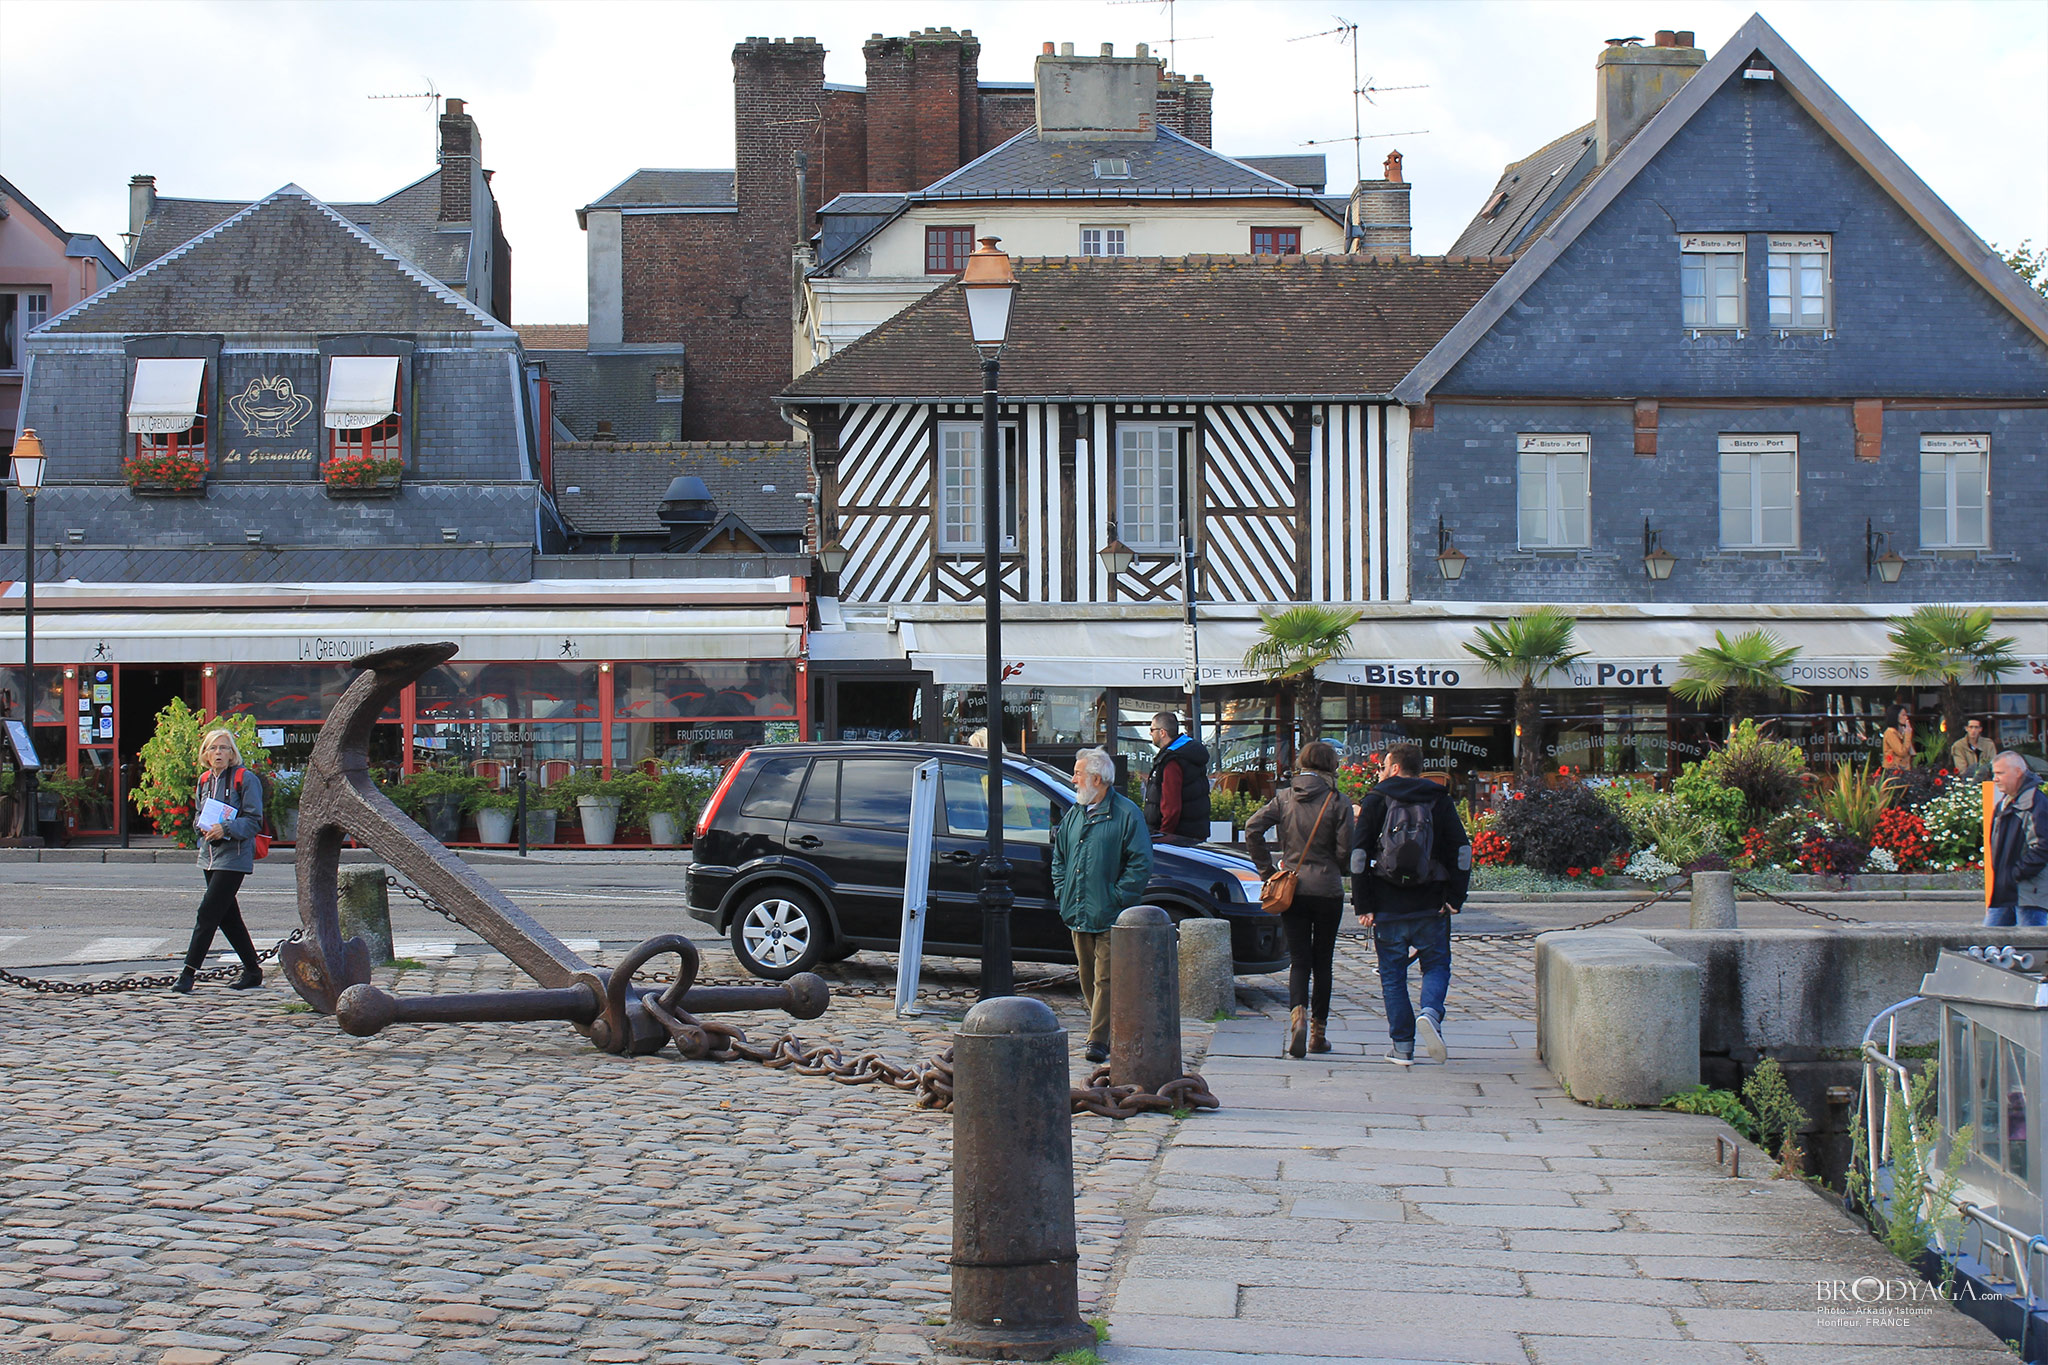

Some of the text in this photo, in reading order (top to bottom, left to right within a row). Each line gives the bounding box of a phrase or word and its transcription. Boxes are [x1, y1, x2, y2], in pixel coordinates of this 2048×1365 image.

[1700, 240, 1721, 248] Bistro
[1726, 239, 1741, 248] Port
[1772, 240, 1793, 248] Bistro
[1797, 240, 1812, 248] Port
[137, 415, 188, 432] LA GRENOUILLE
[333, 413, 342, 427] LA
[1766, 439, 1784, 447] Port
[223, 448, 313, 463] La Grenouille
[298, 637, 375, 661] LA GRENOUILLE
[1143, 668, 1185, 680] FRUIT
[1202, 668, 1222, 679] DE
[1347, 663, 1663, 687] le Bistro du Port
[1791, 666, 1869, 680] POISSONS
[285, 733, 299, 743] VIN
[299, 732, 311, 743] AU
[491, 731, 503, 742] DE
[503, 731, 551, 742] GRENOUILLE
[677, 729, 734, 740] FRUITS DE MER
[1809, 732, 1825, 745] de
[1866, 733, 1881, 747] de
[2001, 733, 2034, 748] Banc
[1343, 735, 1489, 758] Dégustation d'huîtres
[1622, 734, 1637, 746] de
[1641, 736, 1702, 757] poissons
[1423, 755, 1459, 768] andie
